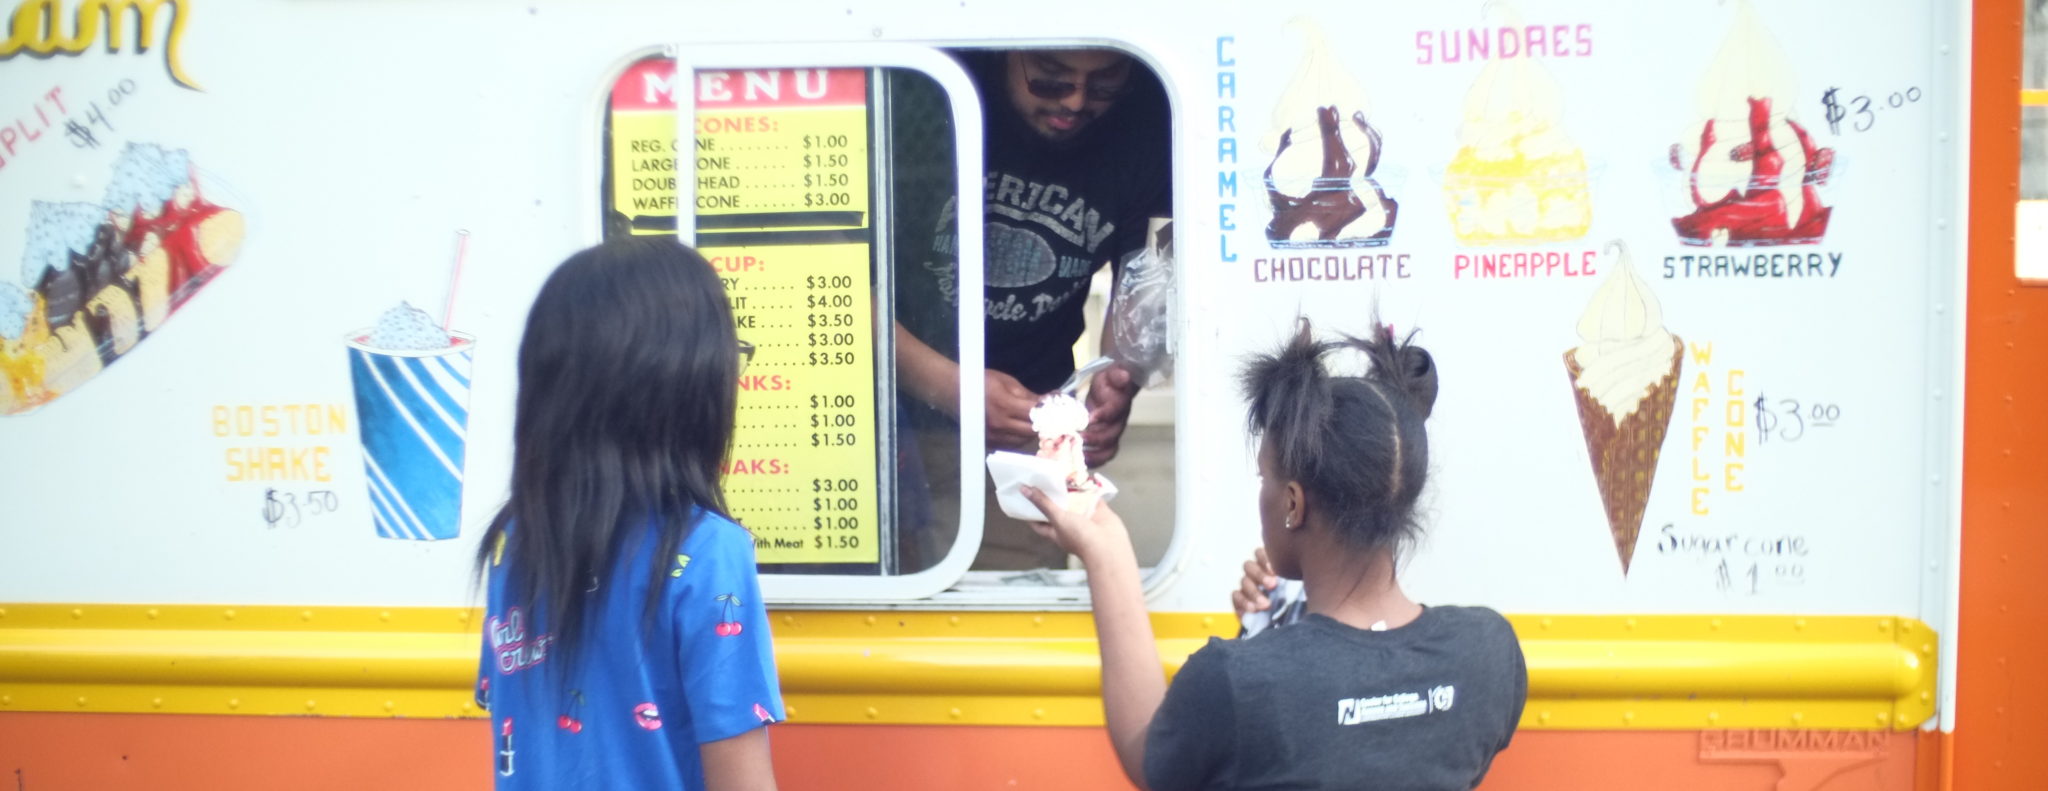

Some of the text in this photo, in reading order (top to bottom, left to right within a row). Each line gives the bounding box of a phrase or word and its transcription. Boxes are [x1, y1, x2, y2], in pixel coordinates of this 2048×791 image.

[1415, 24, 1593, 65] SUNDAES
[643, 70, 829, 103] MENU
[1821, 86, 1922, 136] $3.00
[0, 85, 66, 170] PLIT
[631, 135, 848, 152] REG. CNE $1.00
[1216, 36, 1237, 262] CARAMEL
[696, 157, 730, 170] ONE
[803, 154, 848, 168] $1.50
[632, 173, 849, 191] DOUB HEAD $1.50
[632, 192, 850, 209] WAFF CONE $3.00
[1254, 254, 1411, 282] CHOCOLATE
[1454, 251, 1597, 280] PINEAPPLE
[1662, 252, 1843, 280] STRAWBERRY
[807, 275, 852, 289] $3.00
[807, 294, 853, 308] $4.00
[808, 314, 853, 328] $3.50
[808, 333, 854, 347] $3.00
[809, 352, 855, 366] $3.50
[810, 395, 855, 409] $1.00
[212, 403, 347, 437] BOSTON
[811, 414, 856, 428] $1.00
[1690, 341, 1713, 515] WAFFLE
[1725, 369, 1745, 492] CONE
[811, 433, 856, 447] $1.50
[226, 446, 333, 482] SHAKE
[813, 479, 858, 493] $3.00
[814, 498, 858, 511] $1.00
[814, 517, 859, 531] $1.00
[754, 536, 860, 550] ith Meat $1.50
